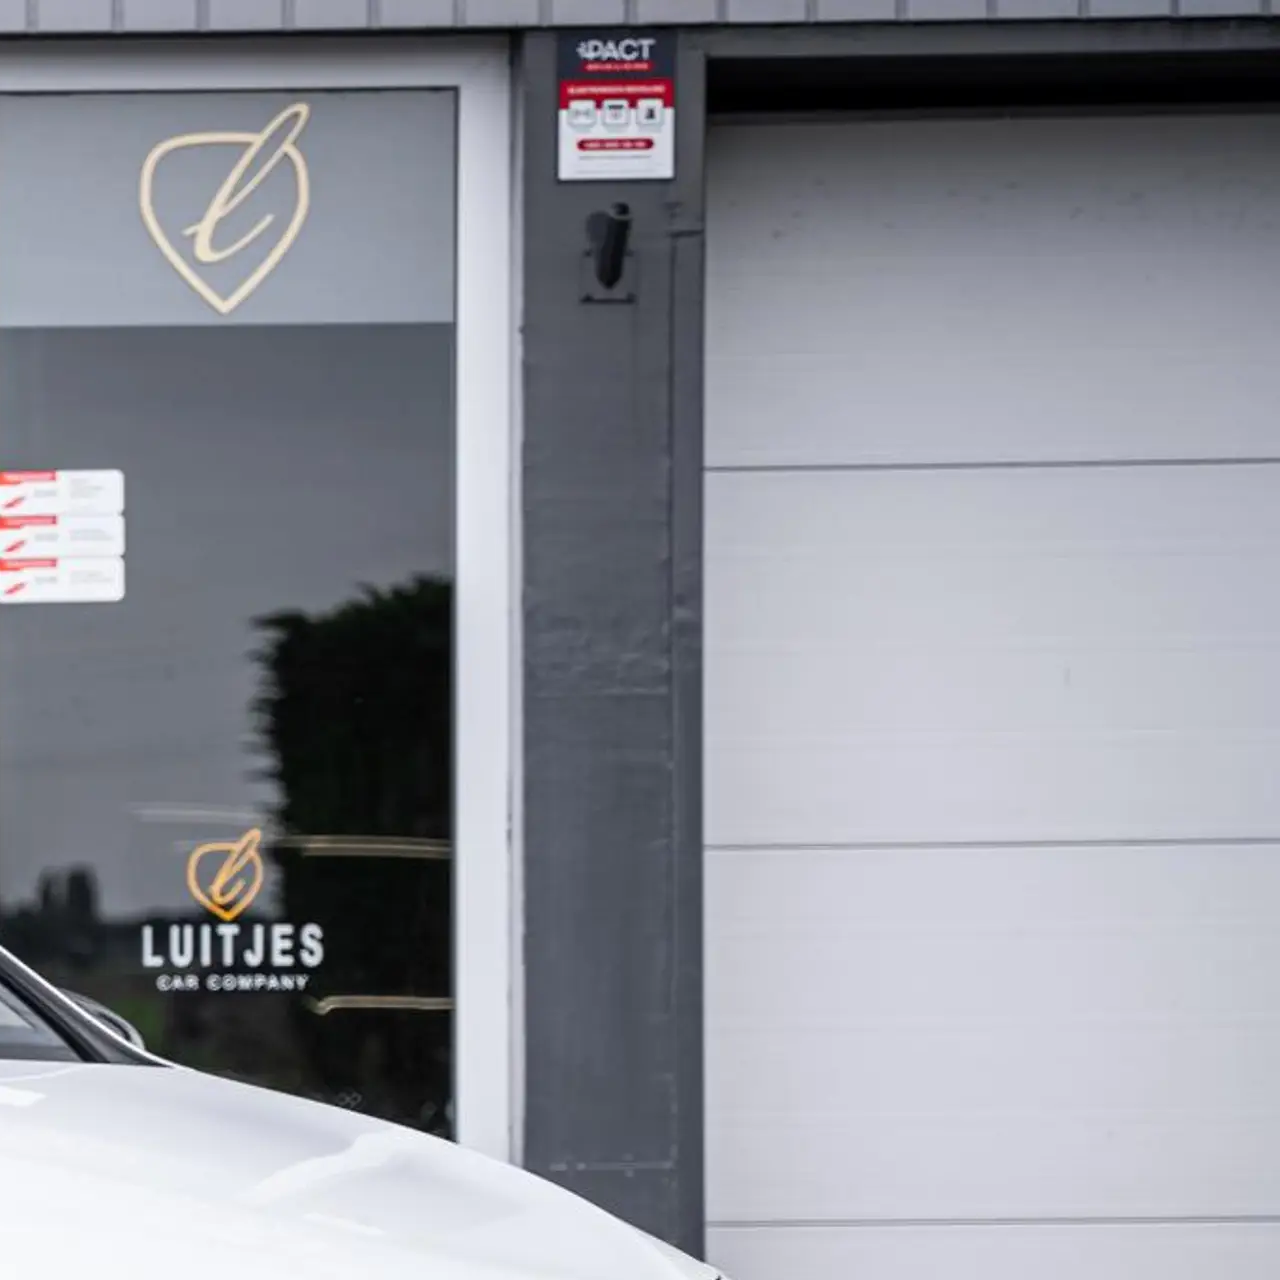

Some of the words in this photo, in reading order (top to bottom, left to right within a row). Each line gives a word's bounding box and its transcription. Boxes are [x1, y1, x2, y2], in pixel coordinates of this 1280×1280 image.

[141, 922, 324, 968] LUITJES
[155, 973, 200, 991] CAR
[205, 973, 310, 991] COMPANY
